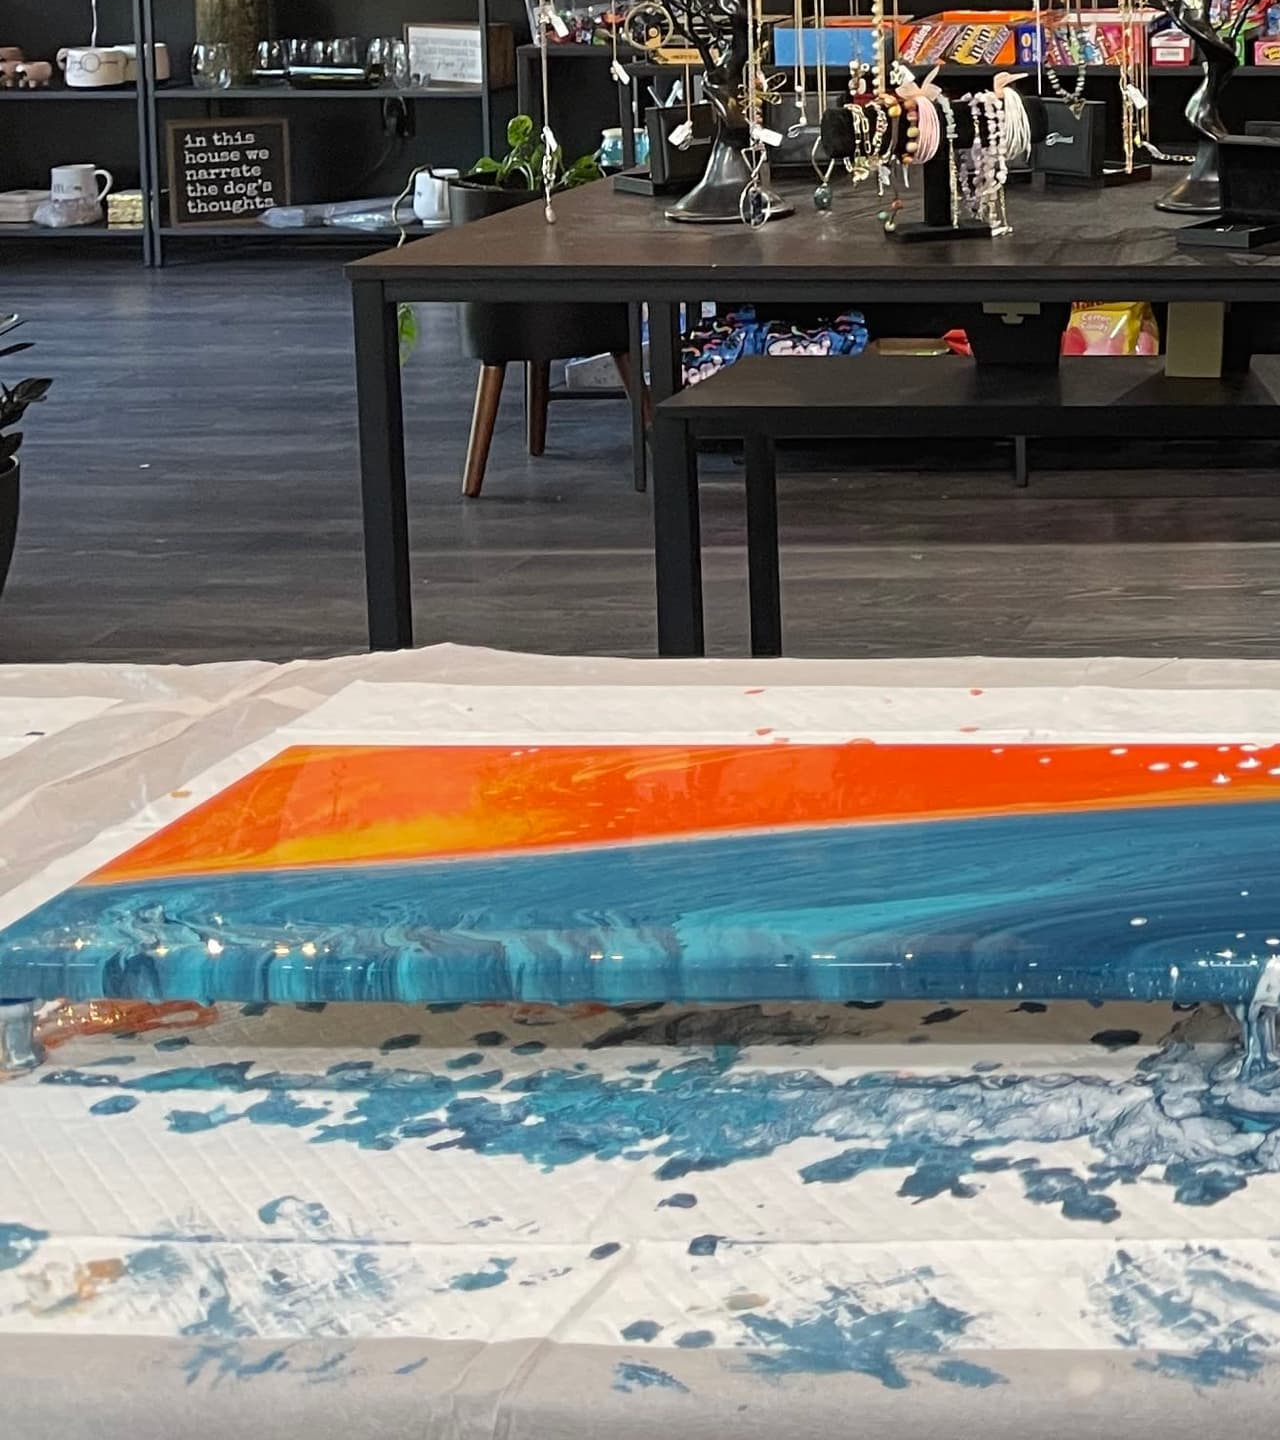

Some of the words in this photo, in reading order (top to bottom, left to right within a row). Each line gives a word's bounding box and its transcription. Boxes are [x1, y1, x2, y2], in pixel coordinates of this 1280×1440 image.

[184, 133, 207, 148] in
[212, 131, 255, 146] this
[184, 150, 241, 164] house
[245, 149, 270, 160] we
[185, 164, 262, 180] narrate
[186, 182, 218, 197] the
[223, 179, 272, 197] dog's
[187, 197, 275, 214] thoughts
